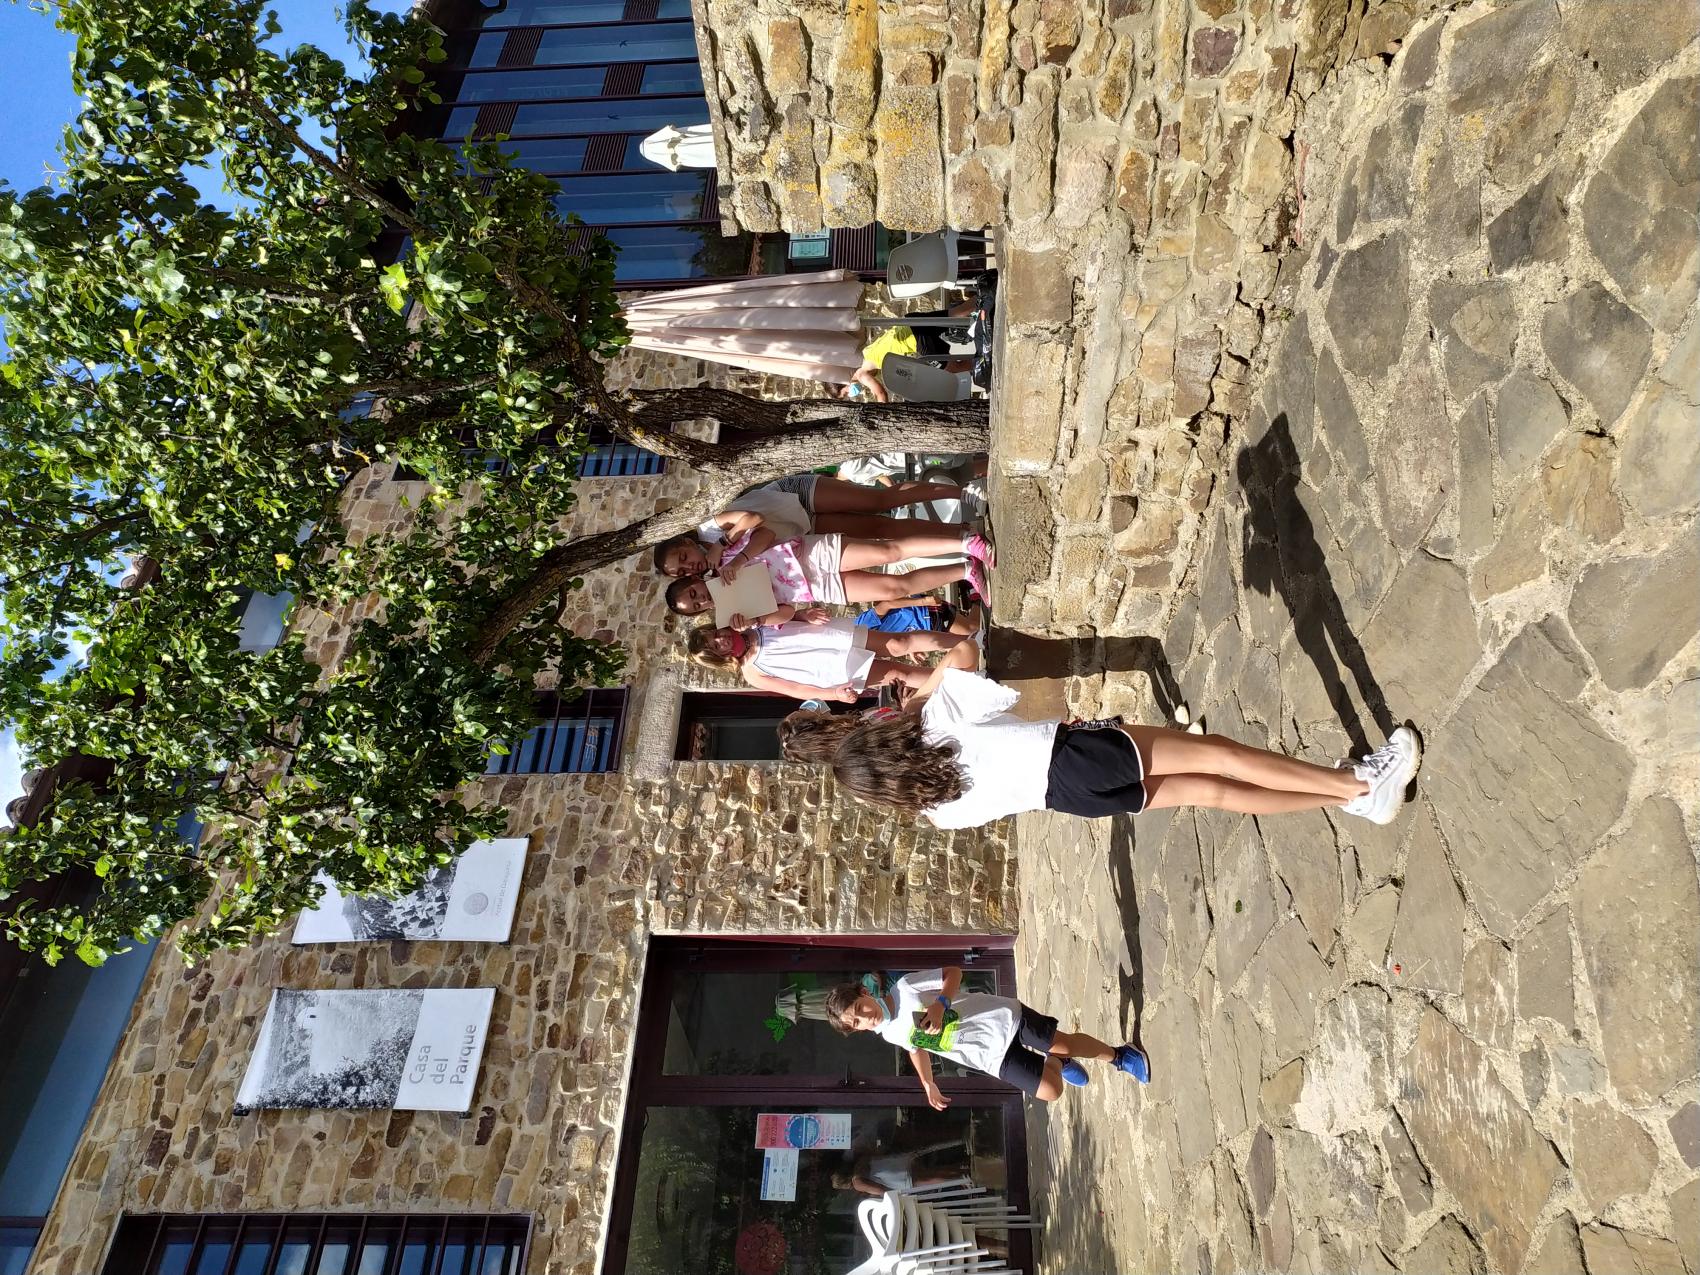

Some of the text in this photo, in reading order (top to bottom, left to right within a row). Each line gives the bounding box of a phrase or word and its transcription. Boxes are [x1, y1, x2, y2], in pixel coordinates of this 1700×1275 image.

[408, 1045, 432, 1084] Casa
[429, 1058, 449, 1085] del
[449, 1024, 477, 1085] Parque
